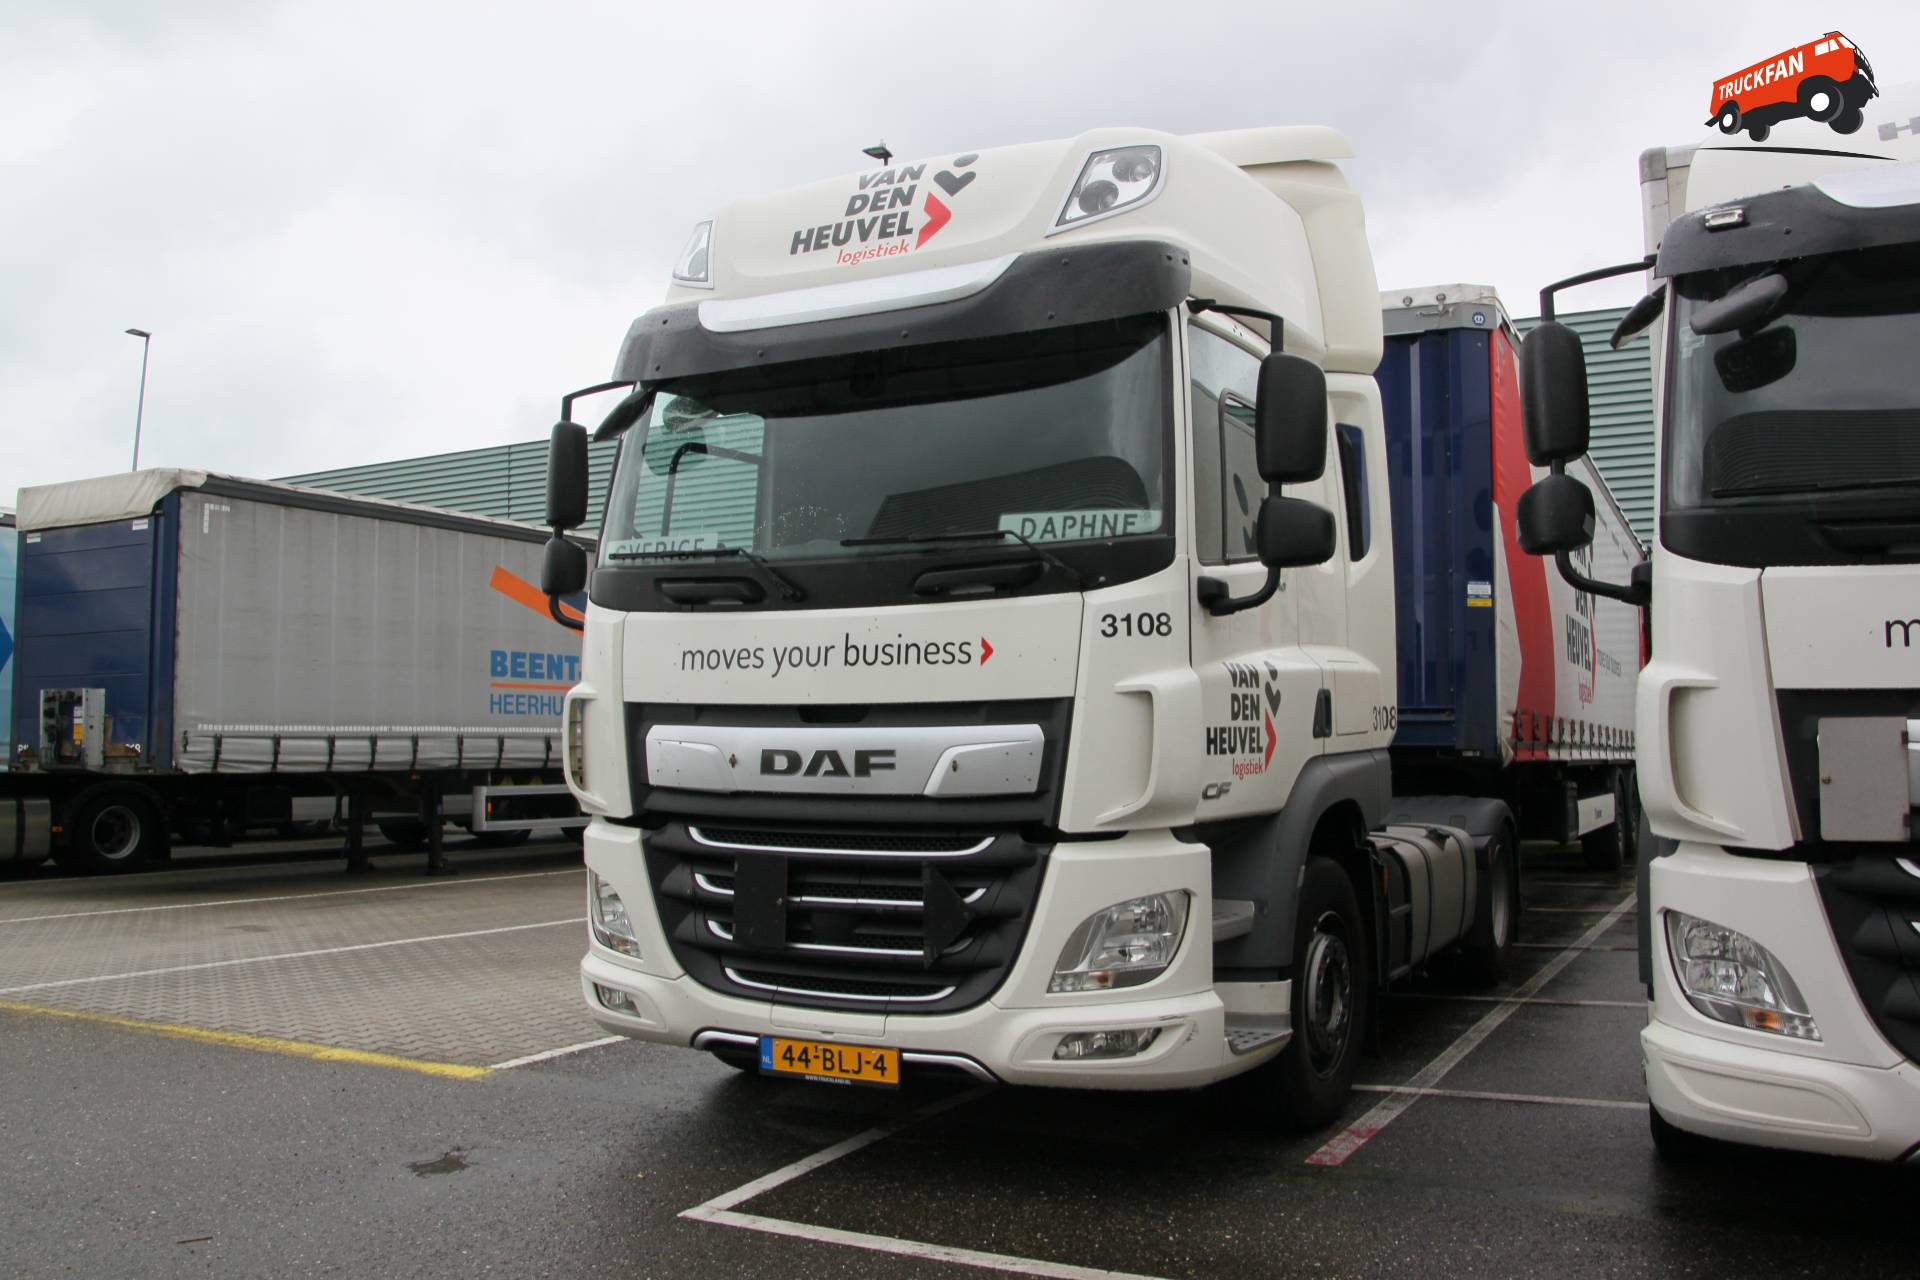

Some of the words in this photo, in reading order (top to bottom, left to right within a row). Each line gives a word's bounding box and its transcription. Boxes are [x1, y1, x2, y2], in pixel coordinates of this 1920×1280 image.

[858, 163, 927, 191] VAN
[844, 184, 918, 217] DEN
[789, 211, 914, 256] HEUVEL
[836, 239, 911, 266] logistiek
[1020, 513, 1138, 541] DAPHNE
[1100, 612, 1172, 638] 3108
[490, 649, 582, 681] BEENT
[681, 646, 765, 671] moves
[771, 644, 836, 678] your
[843, 632, 972, 667] business
[1222, 661, 1260, 689] VAN
[1230, 693, 1260, 721] DEN
[1372, 706, 1397, 732] 3108
[1206, 726, 1264, 755] HEUVEL
[759, 748, 897, 778] DAF
[1232, 757, 1263, 780] logistiek
[1201, 782, 1232, 801] CF
[762, 1055, 772, 1064] NL
[781, 1044, 888, 1077] 44-BLJ-4
